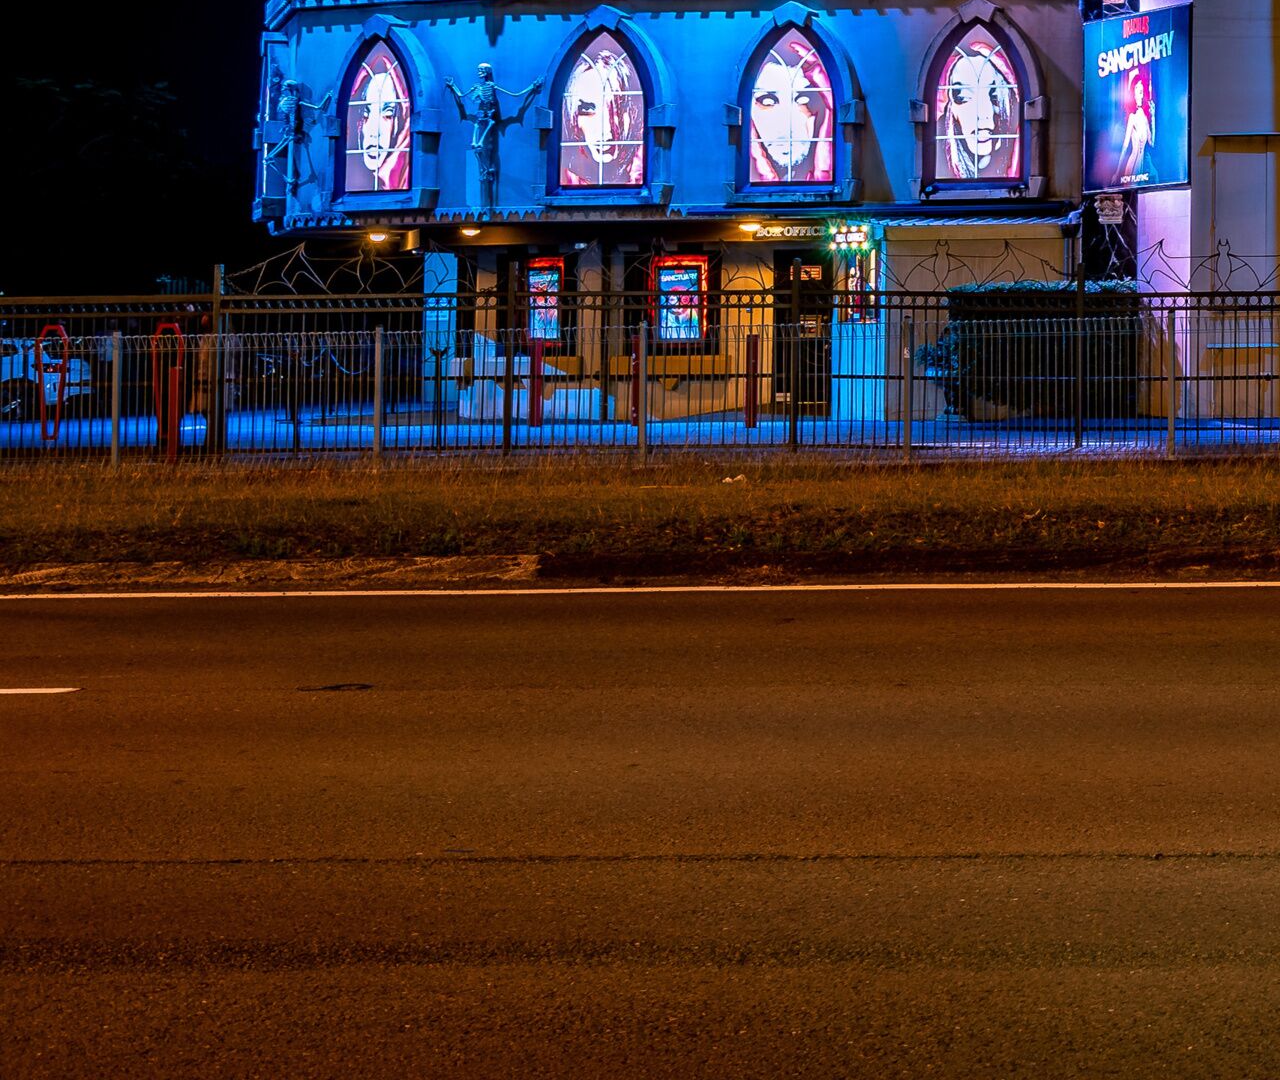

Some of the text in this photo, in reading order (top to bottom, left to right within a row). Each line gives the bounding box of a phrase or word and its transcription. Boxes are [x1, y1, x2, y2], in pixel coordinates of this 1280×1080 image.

[1097, 30, 1175, 78] SANCTUARY
[756, 225, 784, 237] BOX
[660, 272, 698, 283] SANCTUARY
